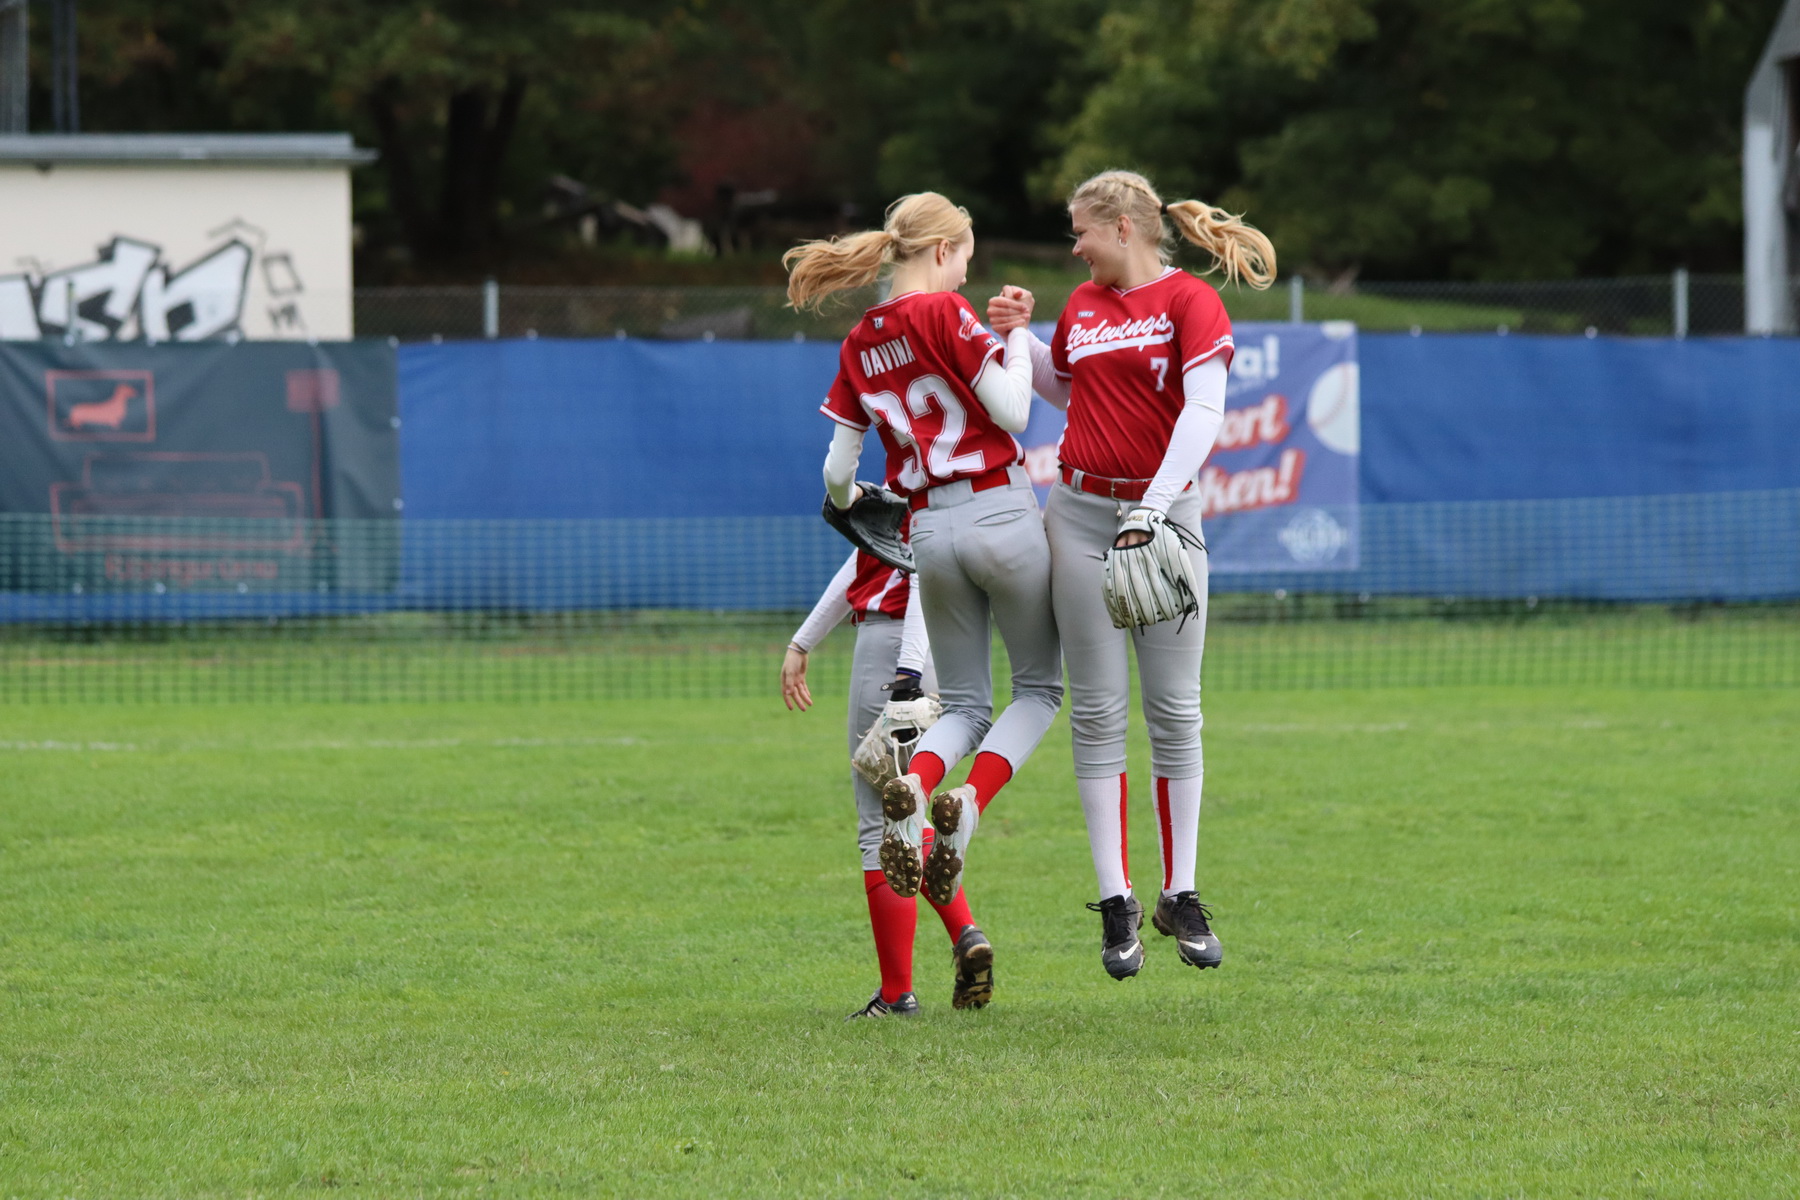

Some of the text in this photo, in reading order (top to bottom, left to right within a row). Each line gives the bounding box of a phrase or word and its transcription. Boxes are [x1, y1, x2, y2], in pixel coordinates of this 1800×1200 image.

[1065, 312, 1174, 352] Redwings
[861, 335, 916, 378] DAVINA
[1151, 357, 1169, 392] 7
[1233, 333, 1280, 379] a!
[860, 374, 985, 492] 32
[1214, 394, 1287, 450] ort
